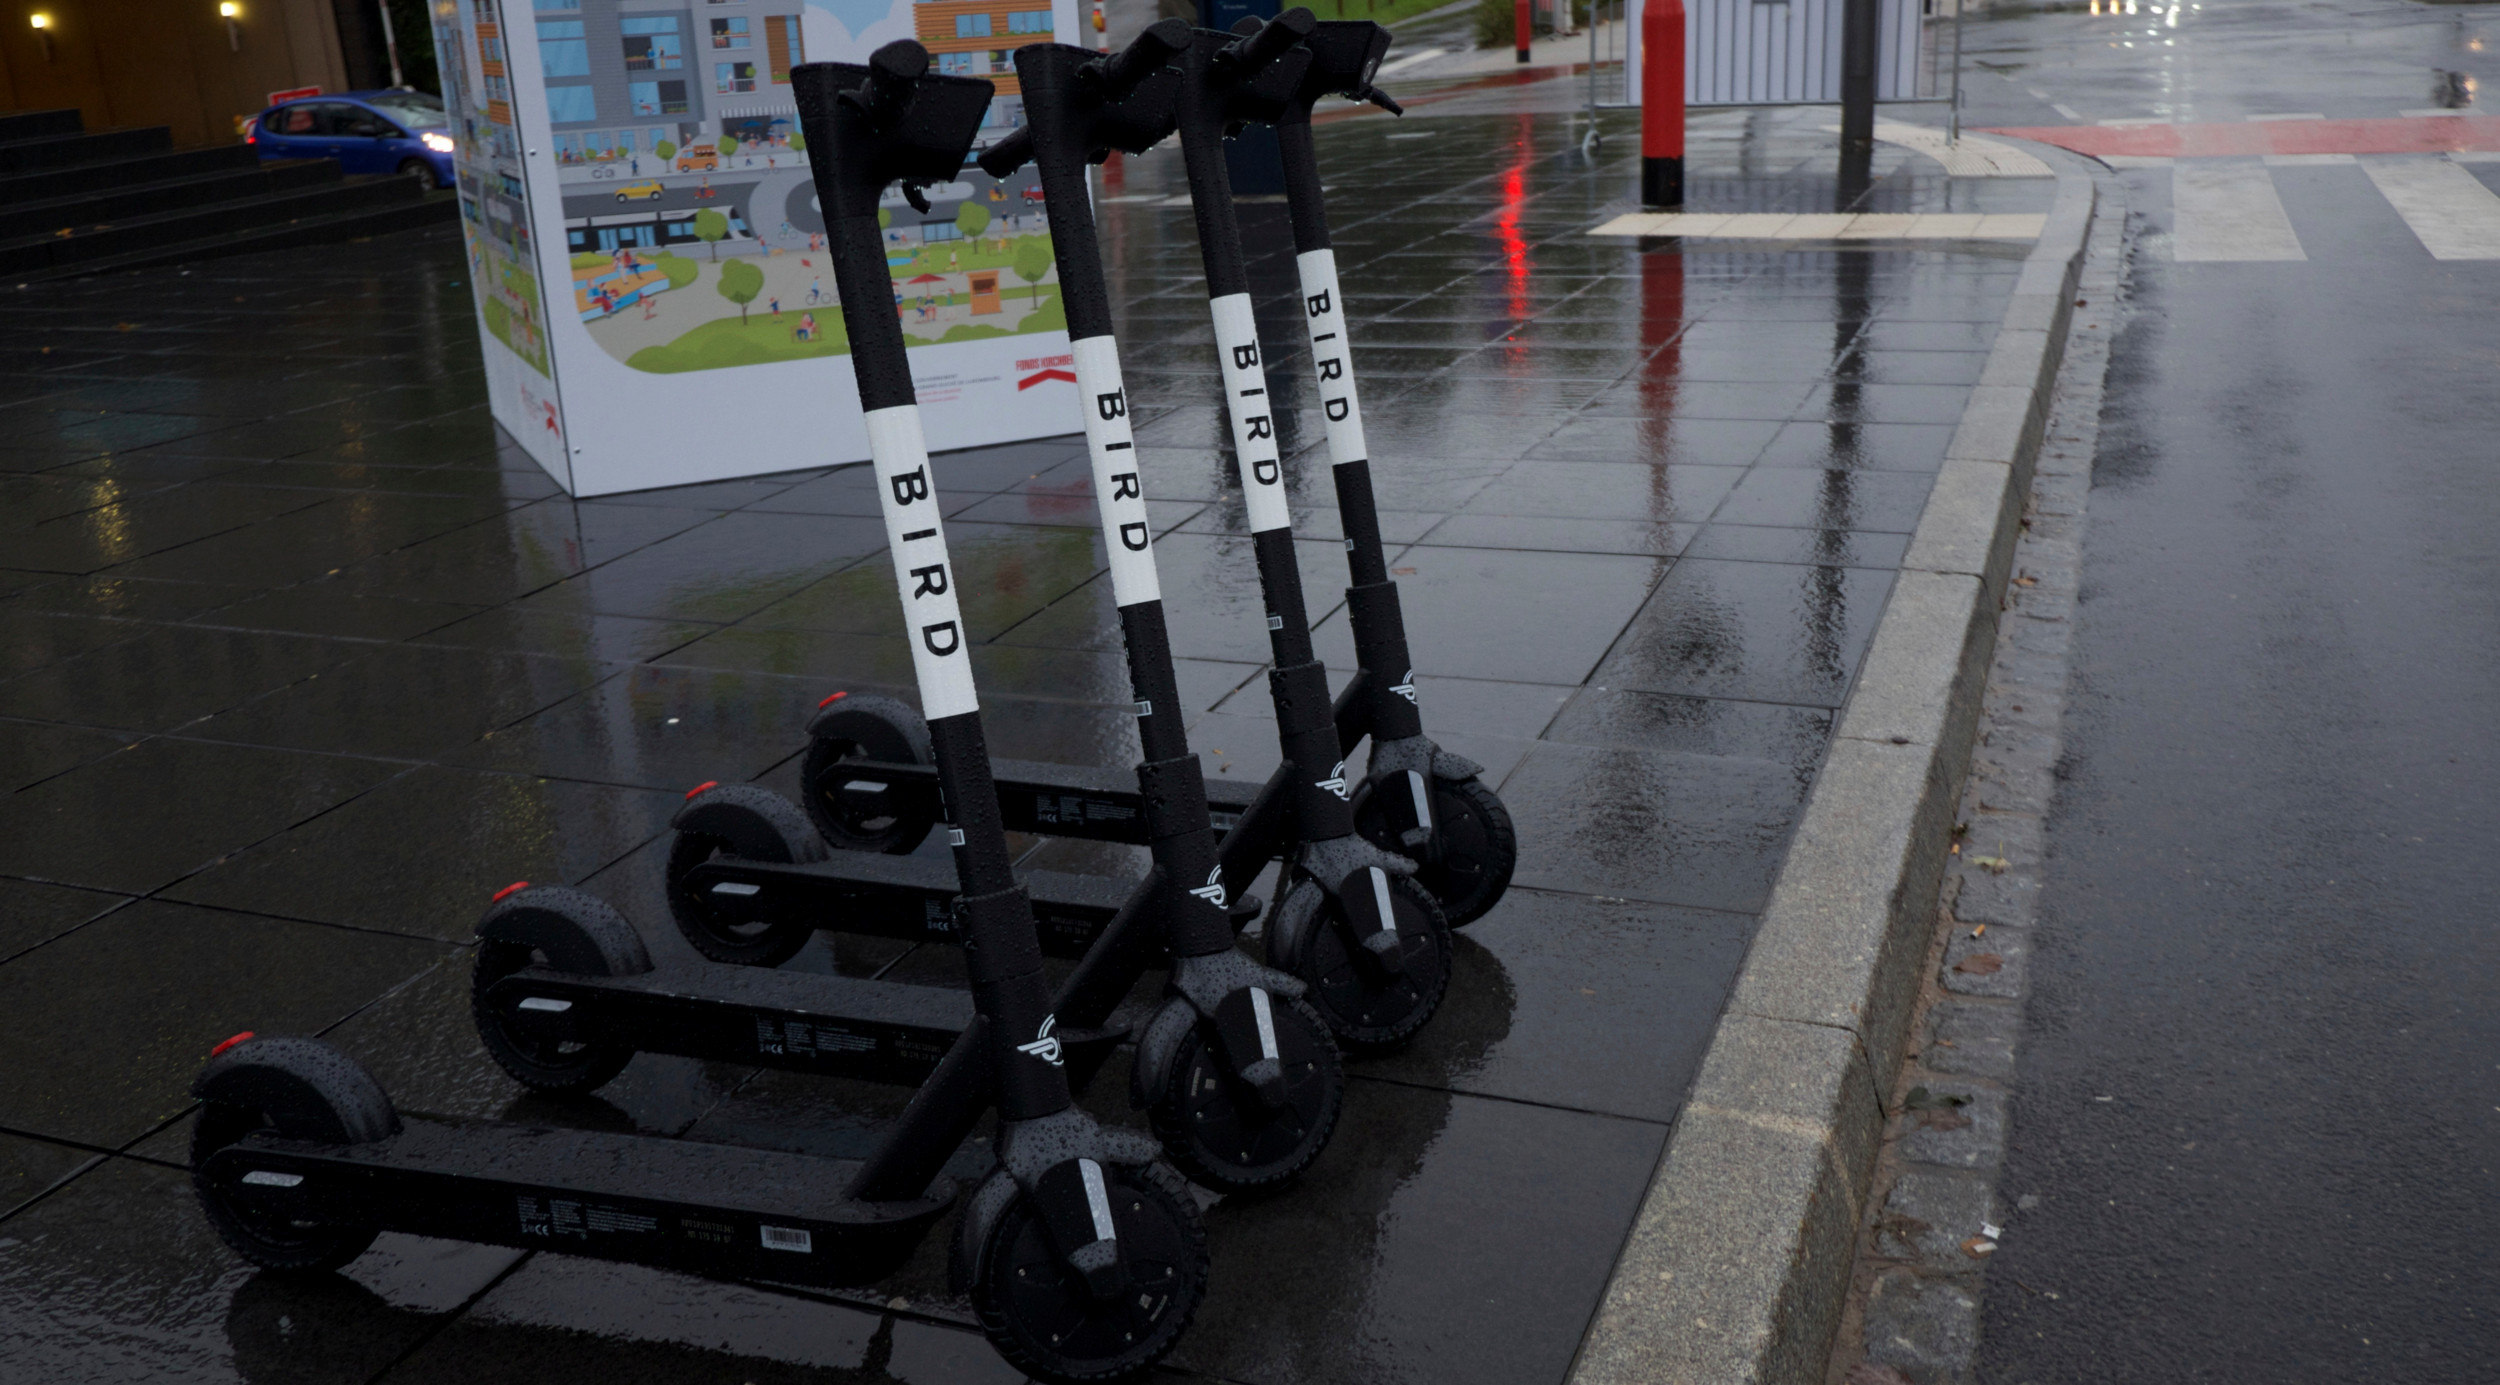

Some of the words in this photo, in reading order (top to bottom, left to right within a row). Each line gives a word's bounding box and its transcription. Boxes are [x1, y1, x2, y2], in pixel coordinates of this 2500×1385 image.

[1015, 358, 1040, 372] FONDS
[1233, 339, 1279, 487] BIRD
[1307, 288, 1349, 423] BIRD
[1097, 386, 1149, 552] BIRD
[891, 464, 960, 657] BIRD
[770, 1043, 784, 1055] CE
[534, 1223, 550, 1237] CE
